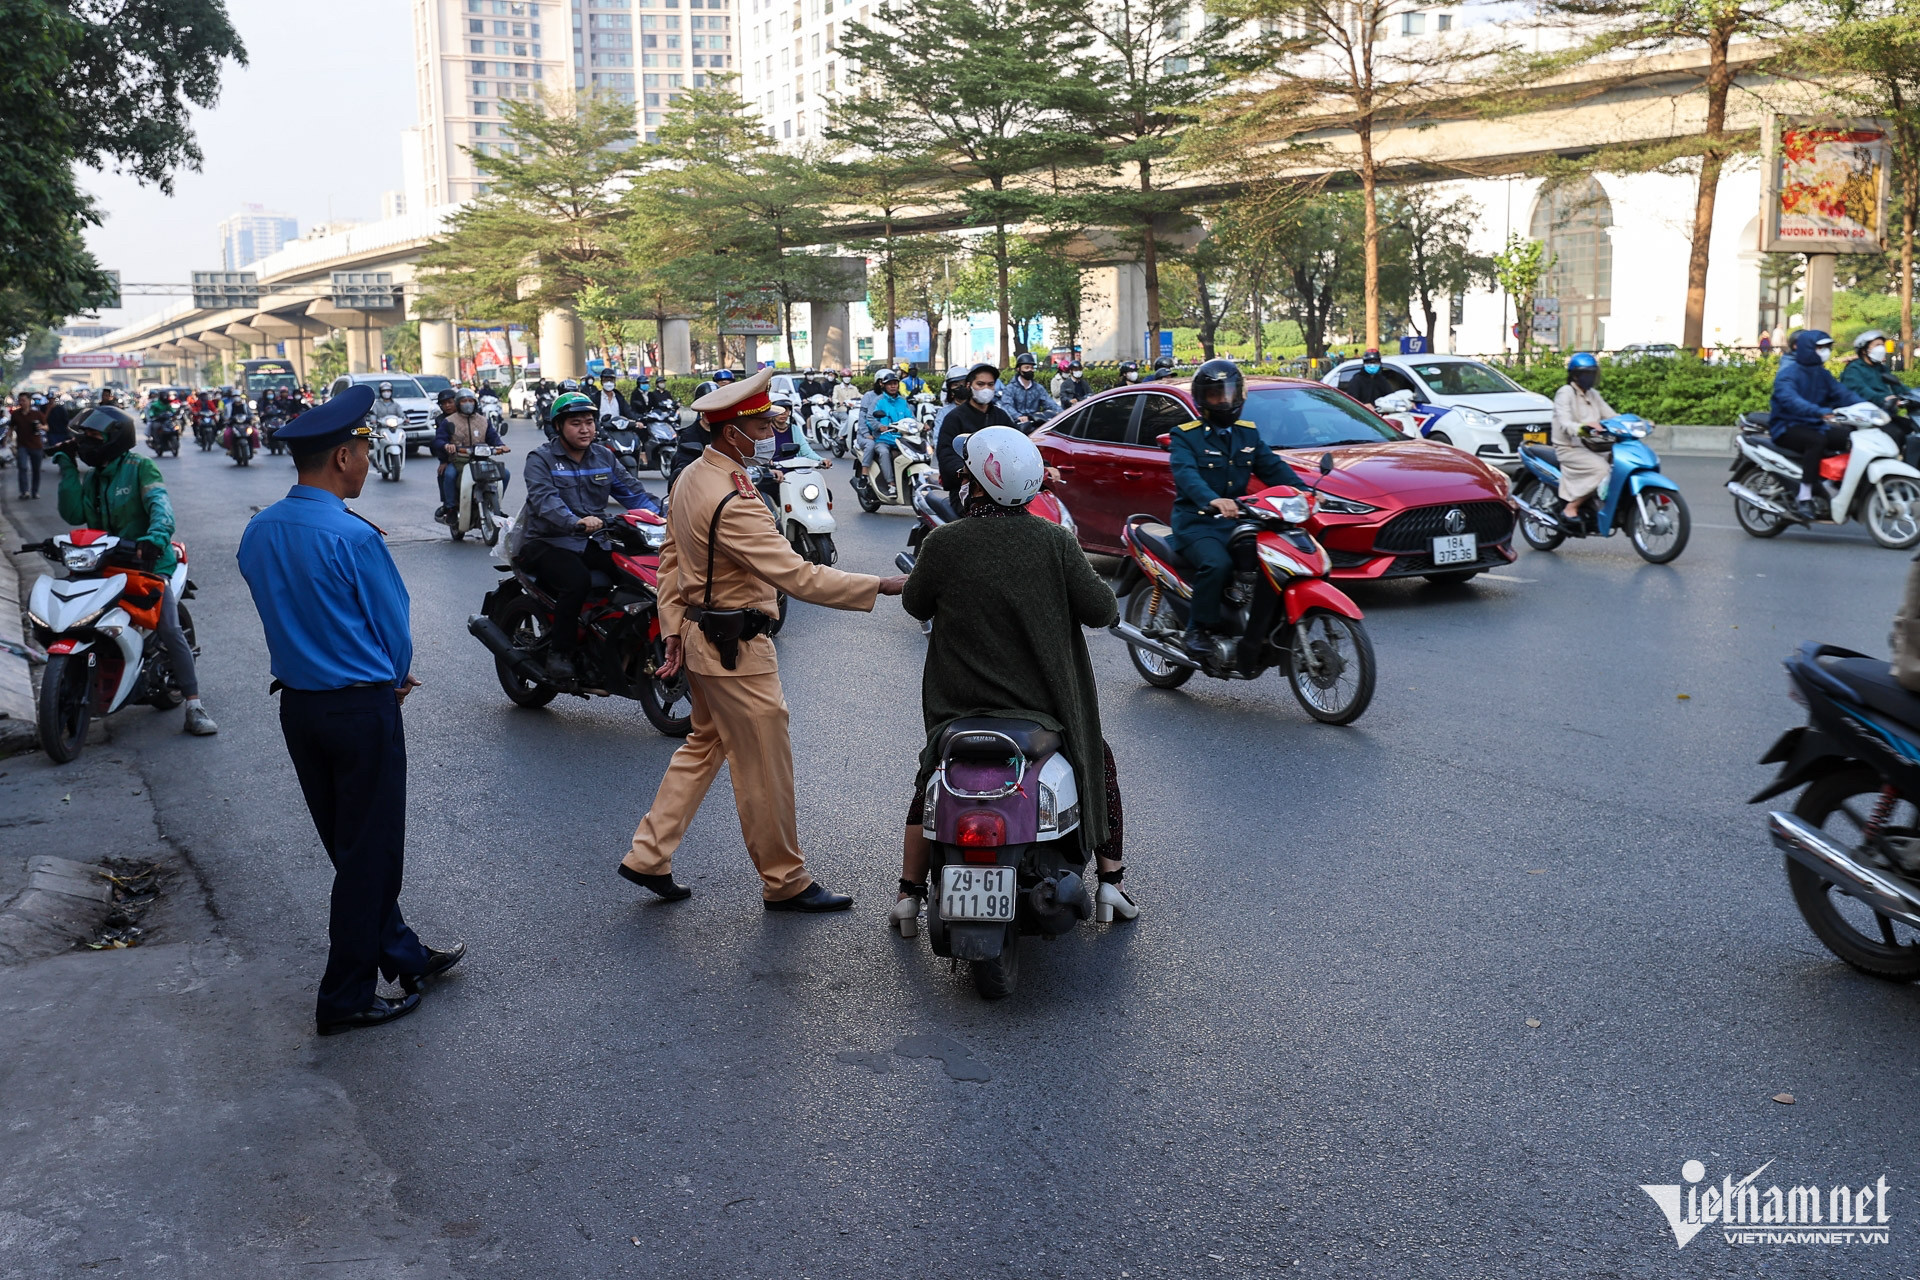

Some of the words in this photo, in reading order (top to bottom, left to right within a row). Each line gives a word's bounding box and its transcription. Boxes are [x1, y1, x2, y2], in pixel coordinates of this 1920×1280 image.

[1446, 537, 1464, 549] 18A
[1438, 548, 1472, 563] 375.36
[946, 894, 1010, 918] 111.98
